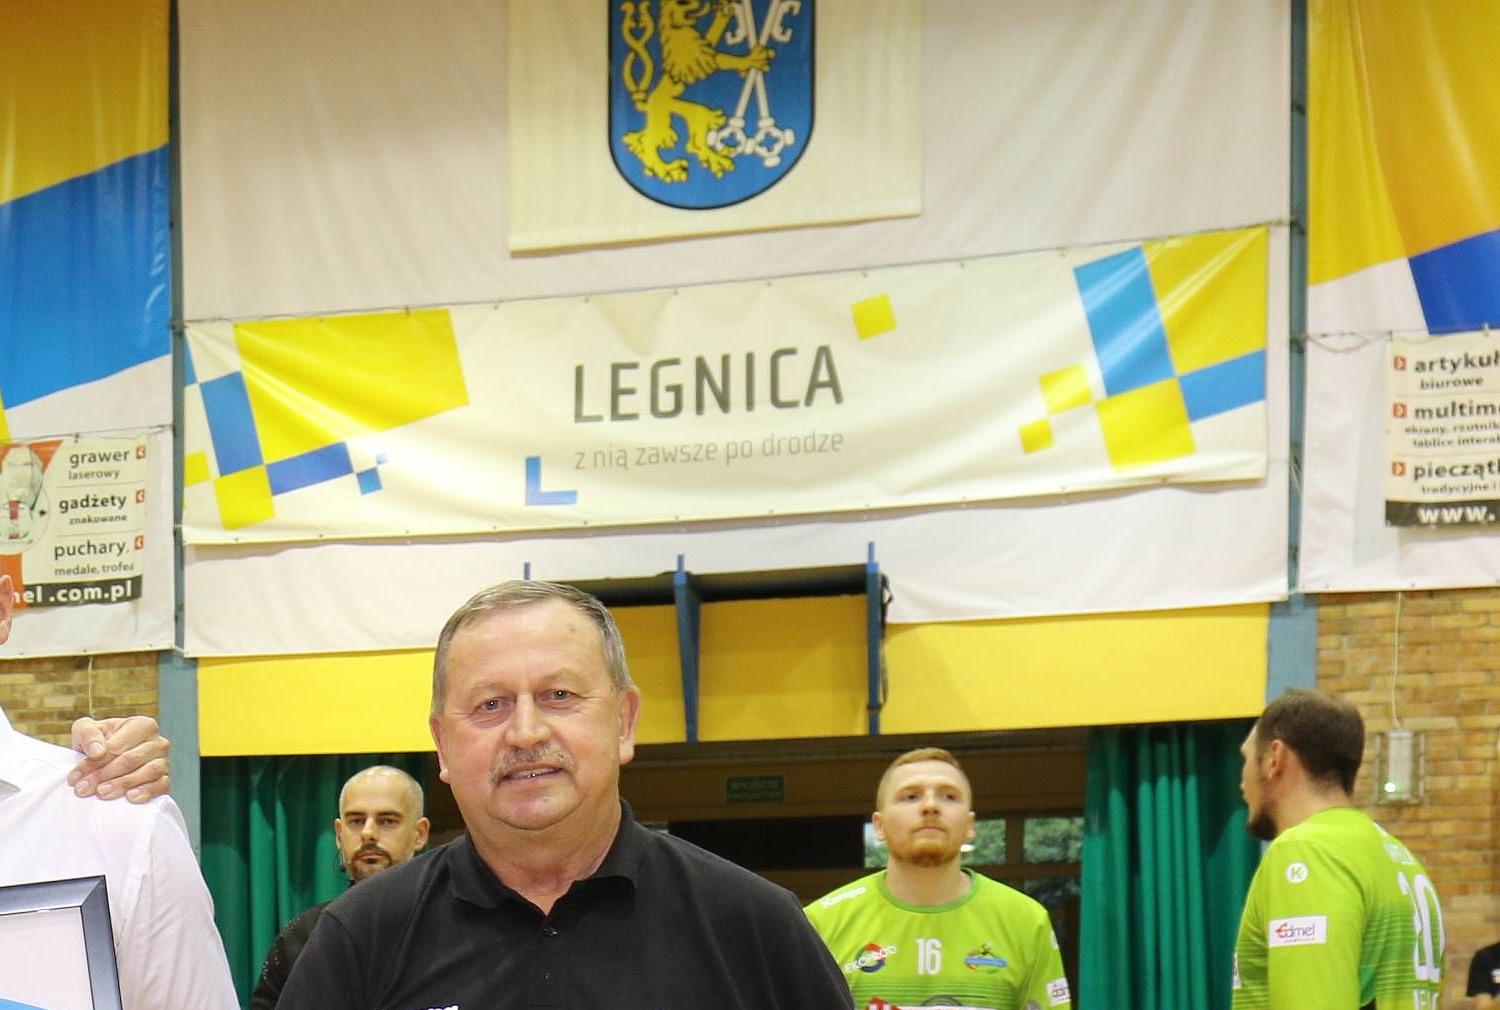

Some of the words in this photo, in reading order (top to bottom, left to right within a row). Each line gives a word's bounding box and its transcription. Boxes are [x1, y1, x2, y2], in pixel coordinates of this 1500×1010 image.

[574, 344, 844, 423] LEGNICA
[1420, 376, 1484, 390] biurowe
[1414, 400, 1500, 419] multim
[69, 448, 131, 468] grawer
[575, 451, 587, 470] z
[593, 445, 628, 471] nią
[635, 441, 718, 466] zawsze
[726, 438, 754, 467] po
[762, 428, 844, 457] drodze
[68, 469, 121, 481] laserowy
[1414, 458, 1500, 482] piecząt
[59, 493, 127, 513] gadżety
[69, 514, 128, 526] znakowane
[916, 937, 942, 976] 16
